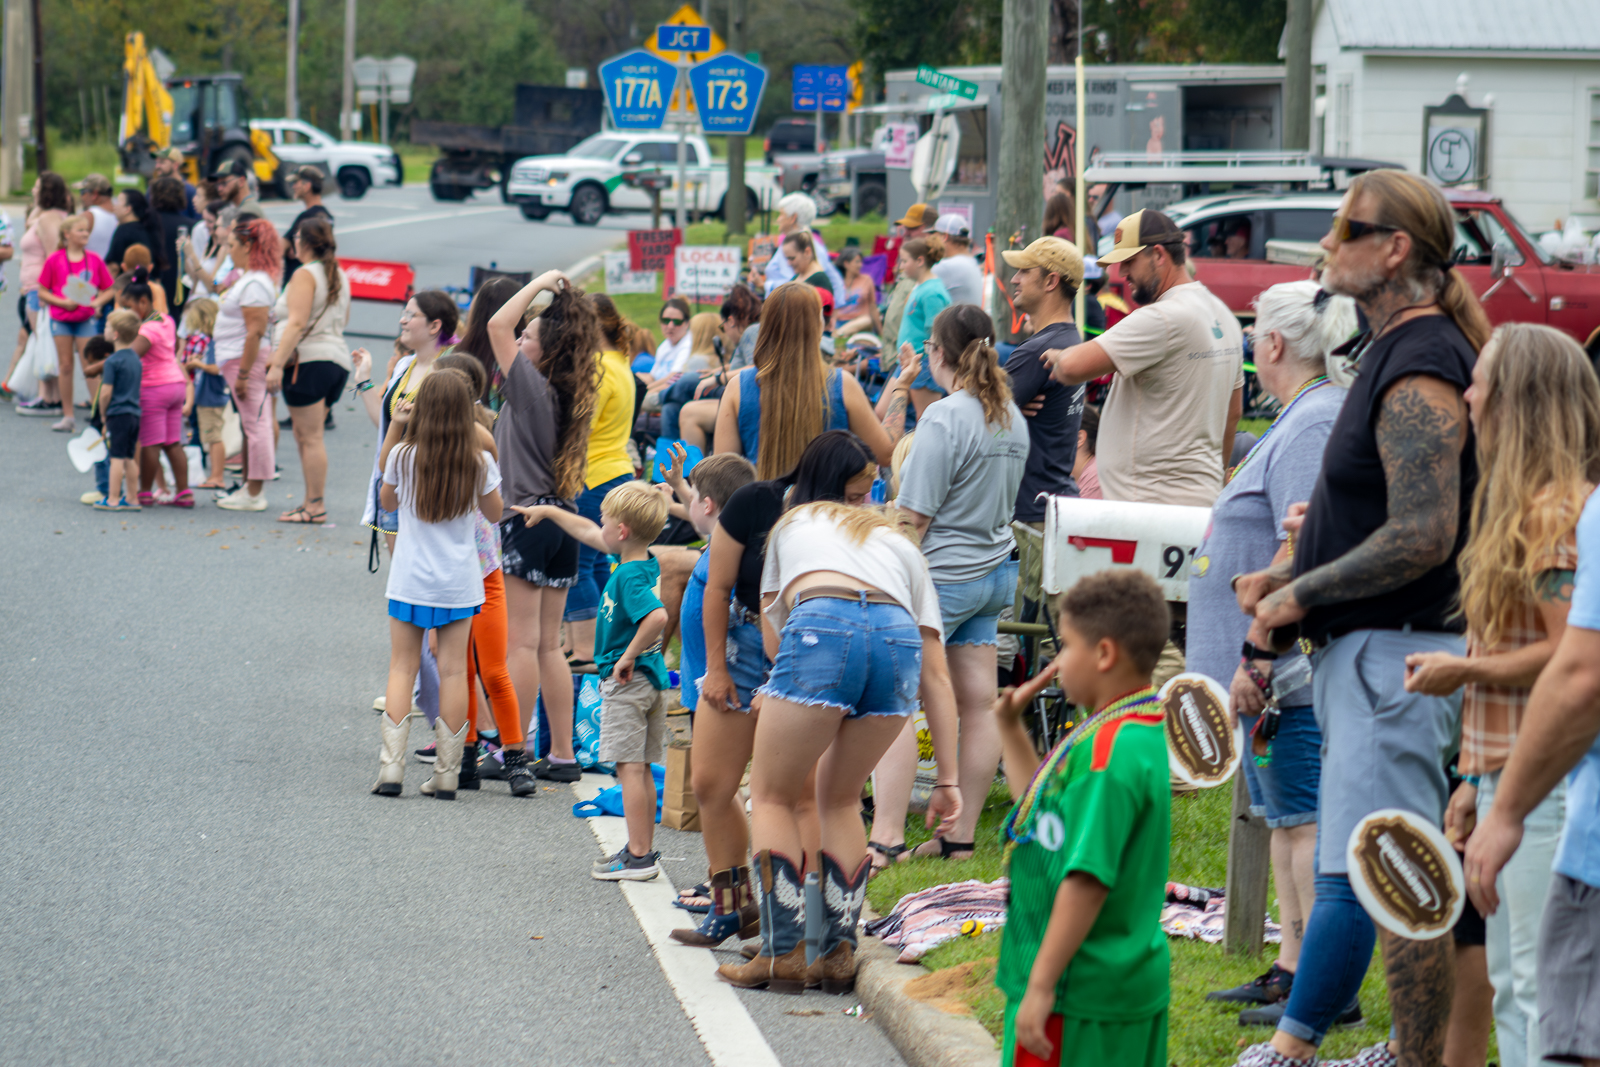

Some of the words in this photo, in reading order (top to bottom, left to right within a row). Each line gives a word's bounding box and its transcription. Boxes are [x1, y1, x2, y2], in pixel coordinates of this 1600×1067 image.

[668, 30, 701, 47] JCT
[919, 68, 960, 91] MONTANA
[615, 78, 663, 109] 177A
[707, 80, 748, 110] 173
[636, 231, 674, 243] FRESH
[641, 244, 671, 256] YARD
[680, 251, 736, 264] LOCAL
[346, 264, 395, 287] Coca-Cola
[685, 268, 716, 277] Grits
[722, 268, 731, 277] &
[1180, 692, 1214, 760] Innovations
[1376, 834, 1432, 907] Innovations
